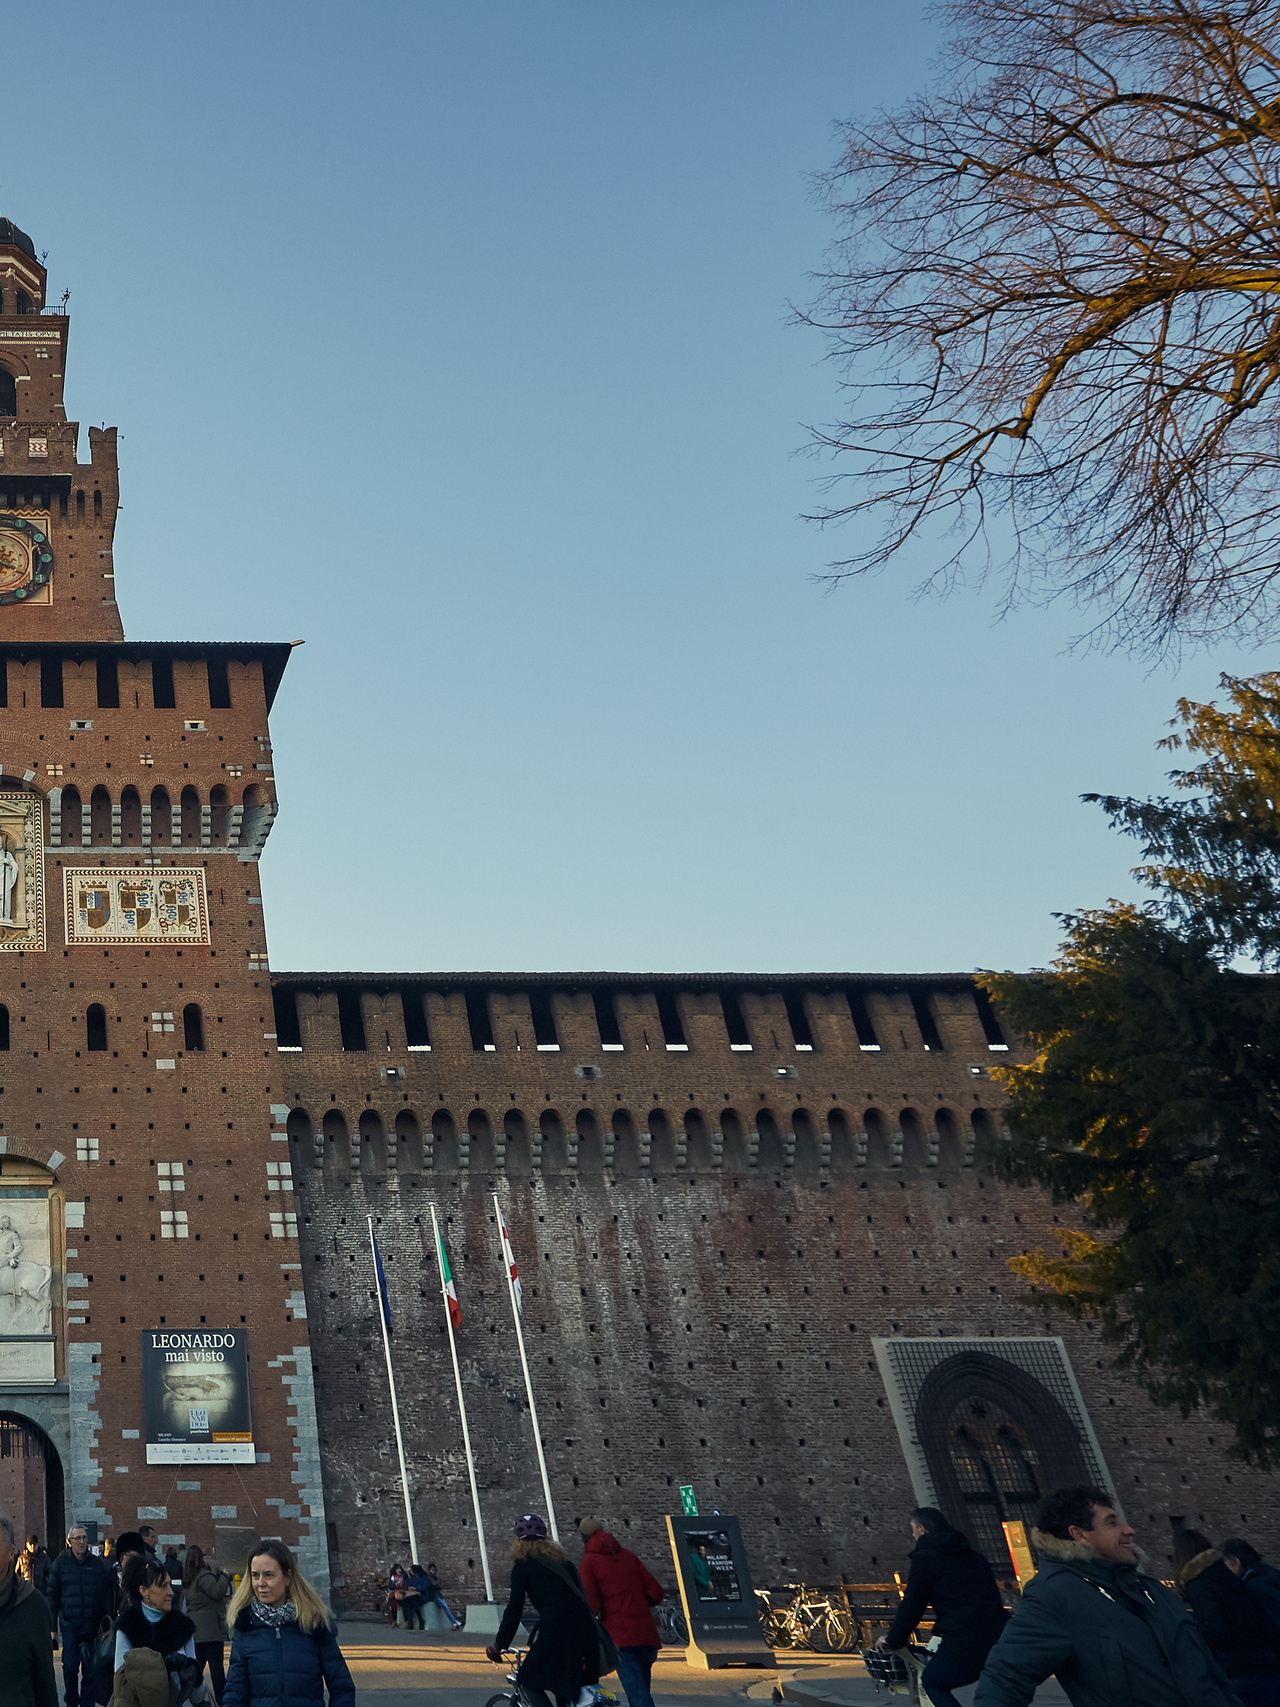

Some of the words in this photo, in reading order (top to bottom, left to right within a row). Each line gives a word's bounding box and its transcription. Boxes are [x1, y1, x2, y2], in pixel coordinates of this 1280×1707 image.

[151, 1334, 236, 1348] LEONARDO
[165, 1349, 190, 1362] mai
[193, 1349, 224, 1362] visto
